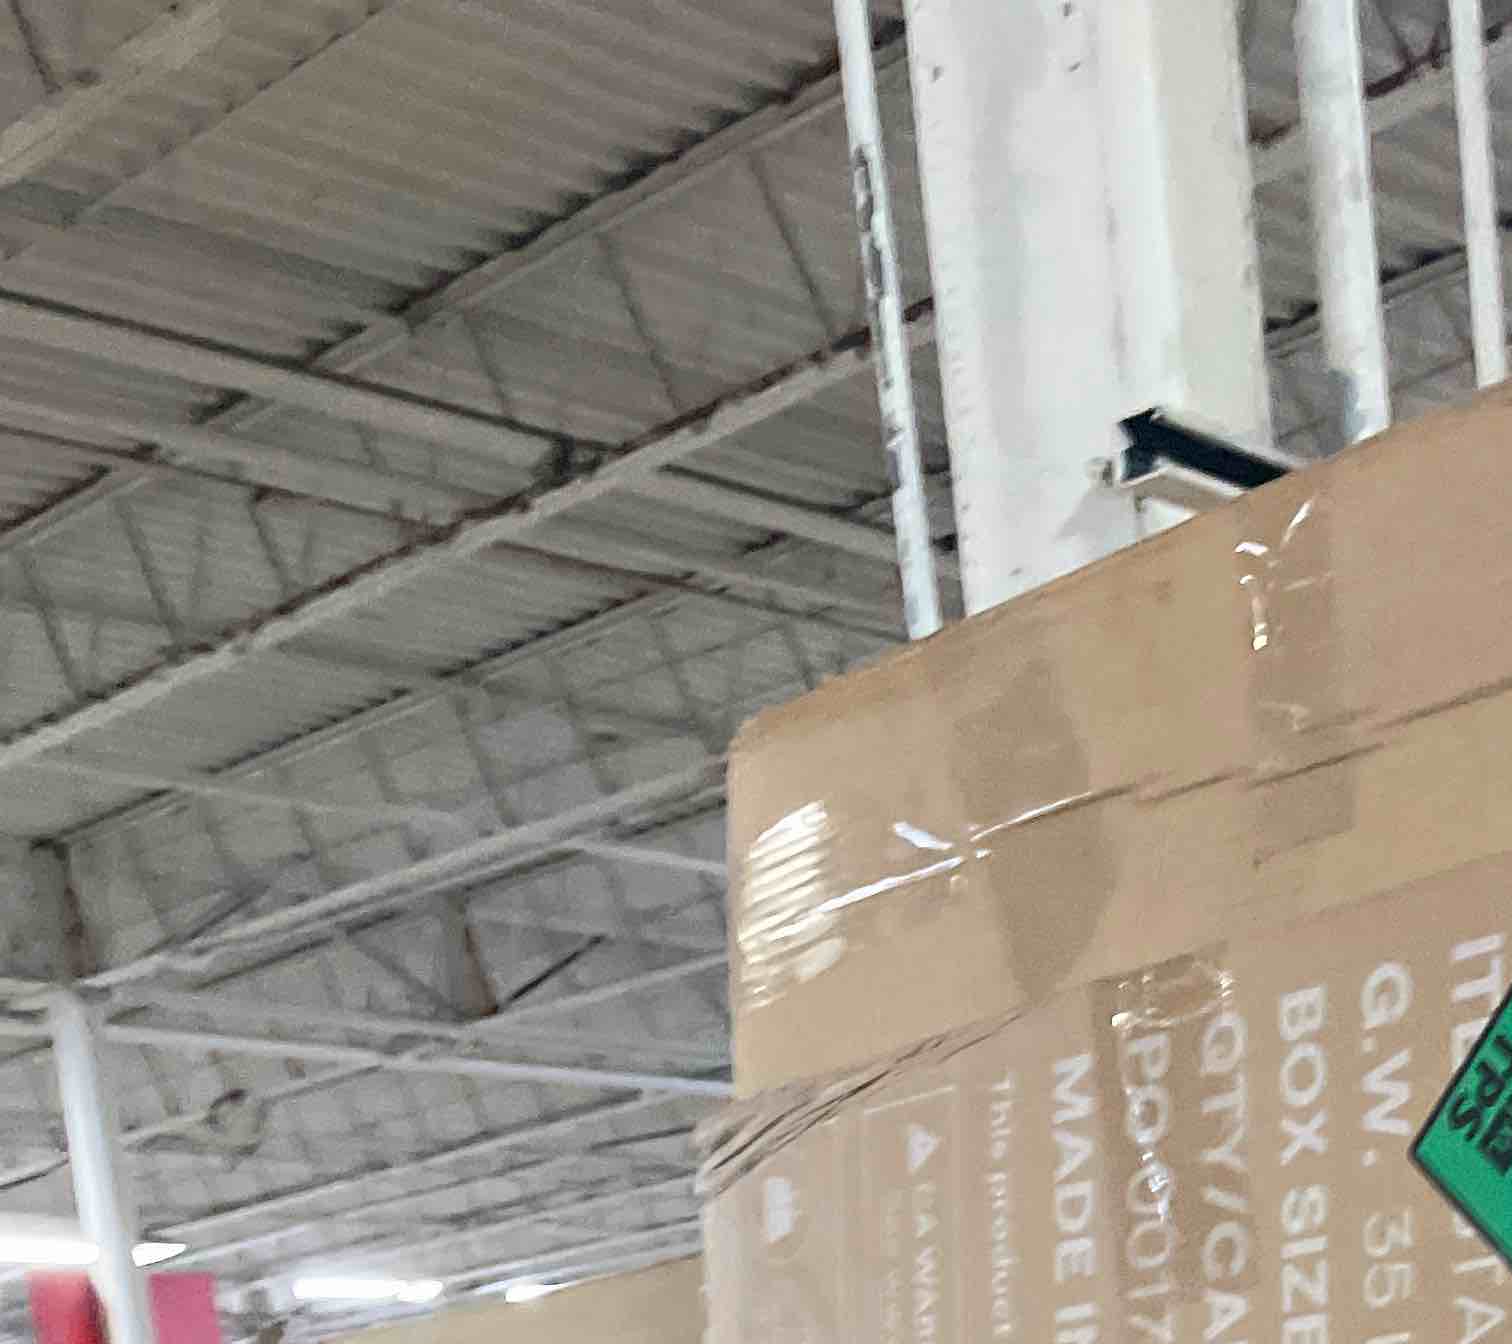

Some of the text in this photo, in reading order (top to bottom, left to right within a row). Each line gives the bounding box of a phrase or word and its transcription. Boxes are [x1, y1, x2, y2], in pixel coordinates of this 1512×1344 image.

[987, 1068, 1015, 1160] This
[1279, 985, 1329, 1166] BOX
[1053, 1052, 1096, 1284] MADE
[983, 1172, 1021, 1337] product
[1362, 1209, 1415, 1309] 35
